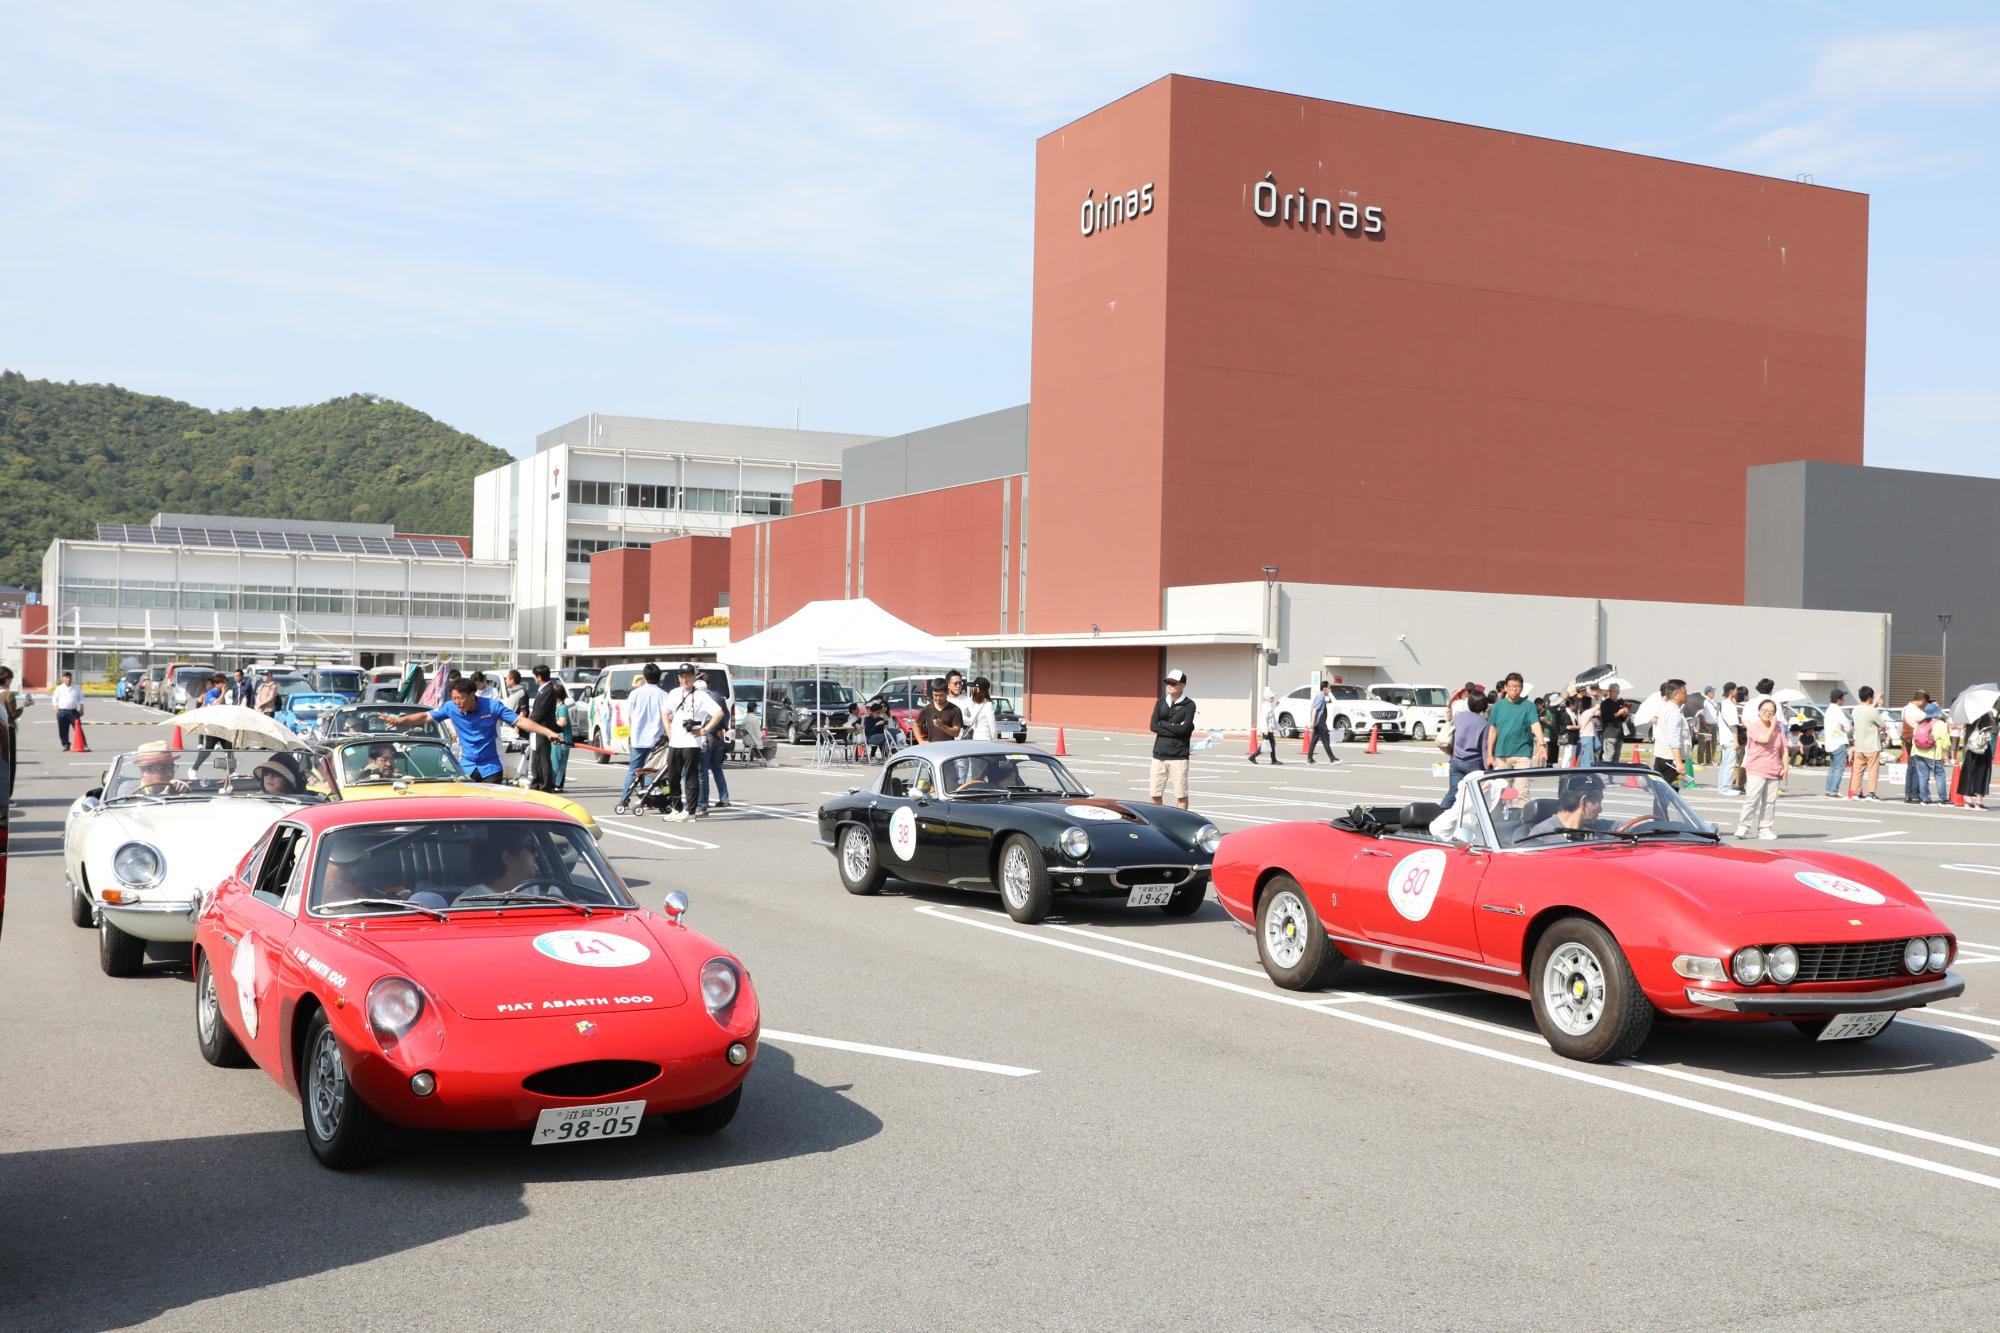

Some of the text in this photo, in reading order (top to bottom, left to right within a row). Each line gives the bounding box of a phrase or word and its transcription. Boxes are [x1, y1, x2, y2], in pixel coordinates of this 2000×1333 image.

[1080, 183, 1154, 236] Órinas
[1254, 171, 1382, 233] Órinas
[898, 824, 909, 844] 38
[1402, 867, 1430, 896] 80
[1138, 893, 1170, 905] 19-62
[574, 939, 615, 953] 41
[497, 995, 654, 1012] FIAT ABARTH 1000
[1834, 1022, 1884, 1037] 77-26
[564, 1106, 620, 1119] 滋賀501
[541, 1116, 636, 1139] や 98-05
